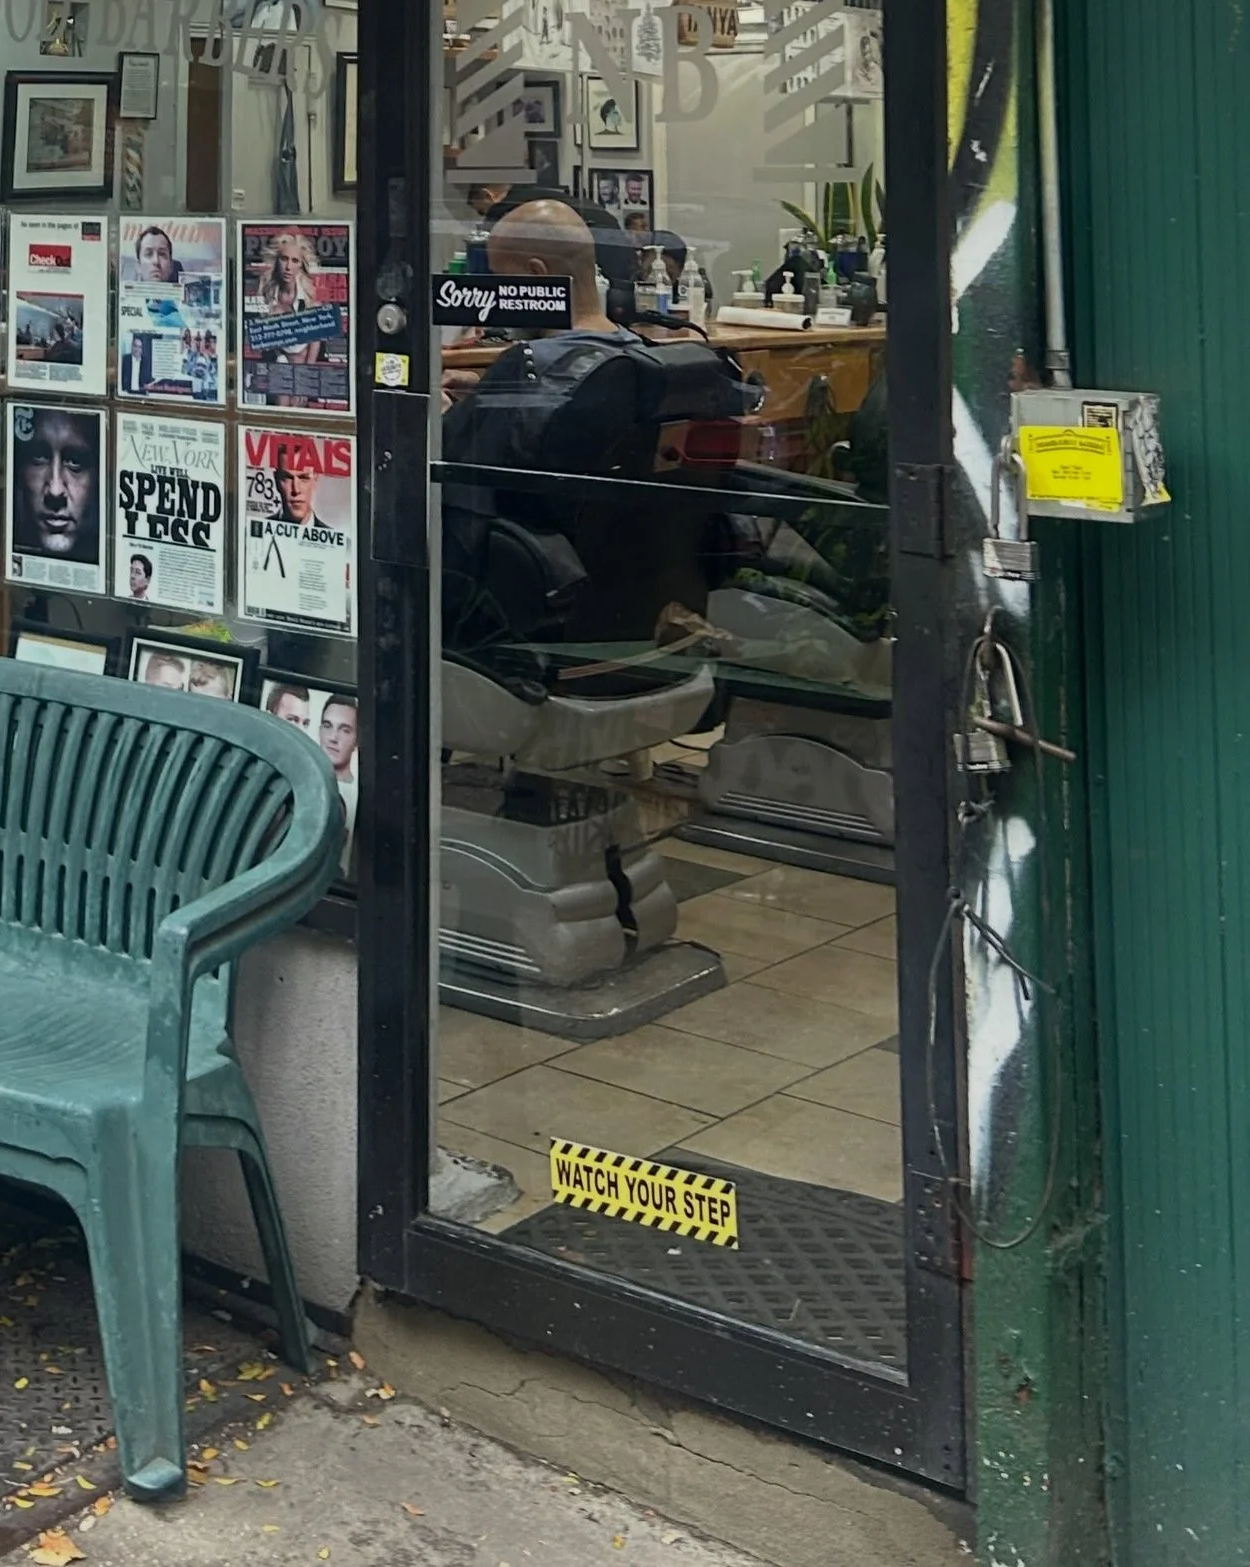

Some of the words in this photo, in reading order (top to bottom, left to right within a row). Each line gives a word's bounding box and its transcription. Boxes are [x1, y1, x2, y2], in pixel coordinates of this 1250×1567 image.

[565, 3, 720, 125] NB
[436, 280, 497, 322] Sorry
[499, 285, 517, 296] NO
[519, 286, 566, 297] PUBLIC
[499, 298, 566, 311] RESTROOM
[119, 470, 222, 523] SPEND
[264, 521, 273, 536] A
[276, 523, 299, 539] CUT
[302, 527, 344, 546] ABOVE
[556, 1158, 619, 1200] WATCH
[624, 1174, 677, 1215] YOUR
[684, 1190, 730, 1227] STEP
